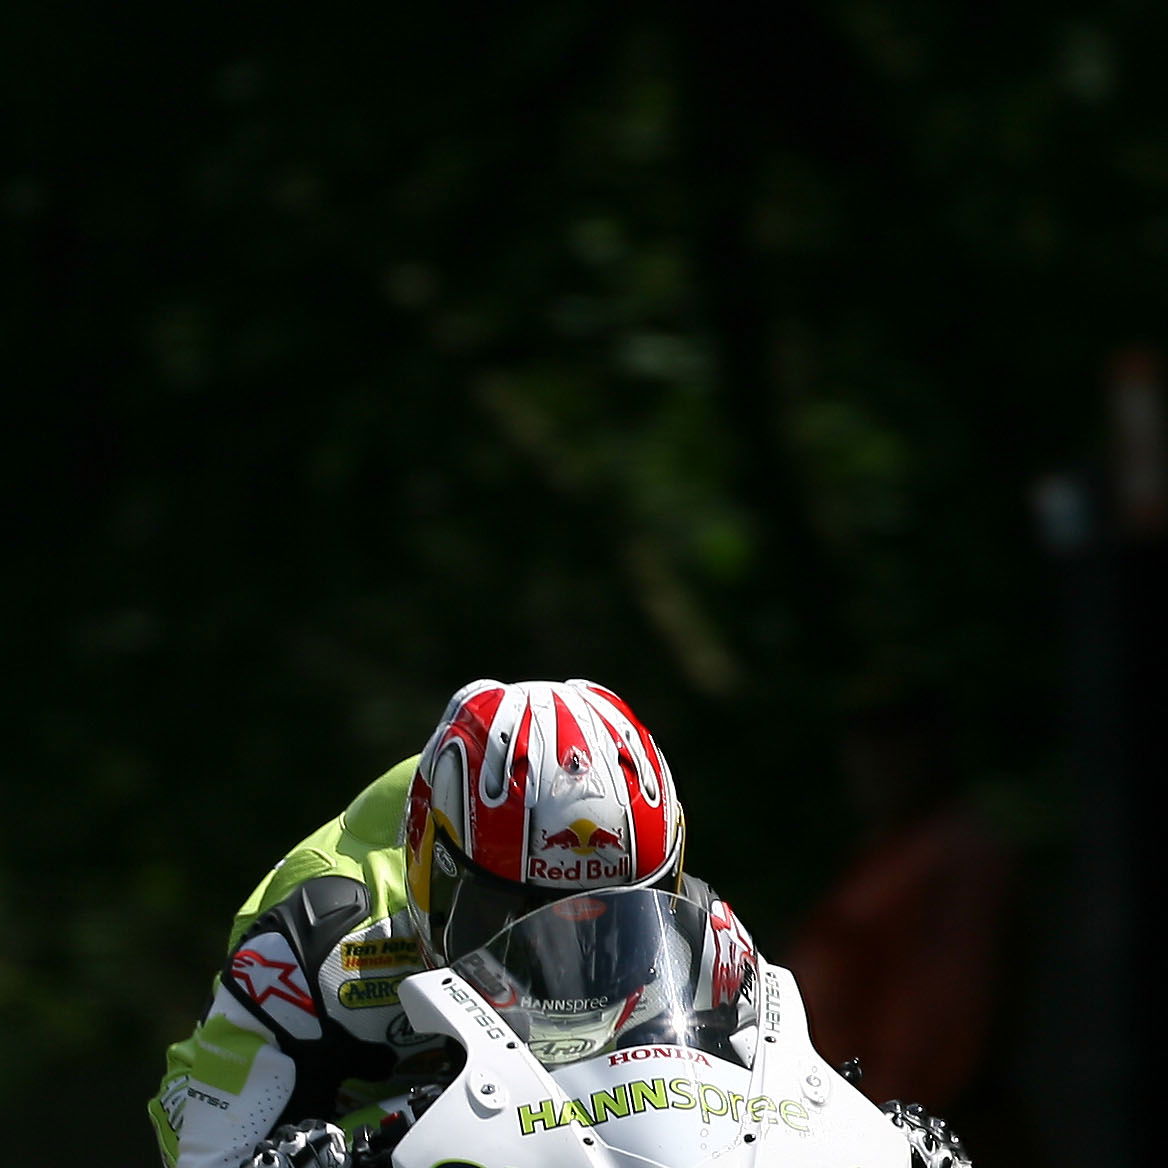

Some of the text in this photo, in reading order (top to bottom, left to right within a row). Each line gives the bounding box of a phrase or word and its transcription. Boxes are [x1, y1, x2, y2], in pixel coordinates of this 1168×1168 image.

[531, 855, 632, 882] Red Bull
[519, 993, 609, 1014] HANNspree
[607, 1046, 713, 1068] HONDA
[516, 1077, 811, 1136] HANNspree
